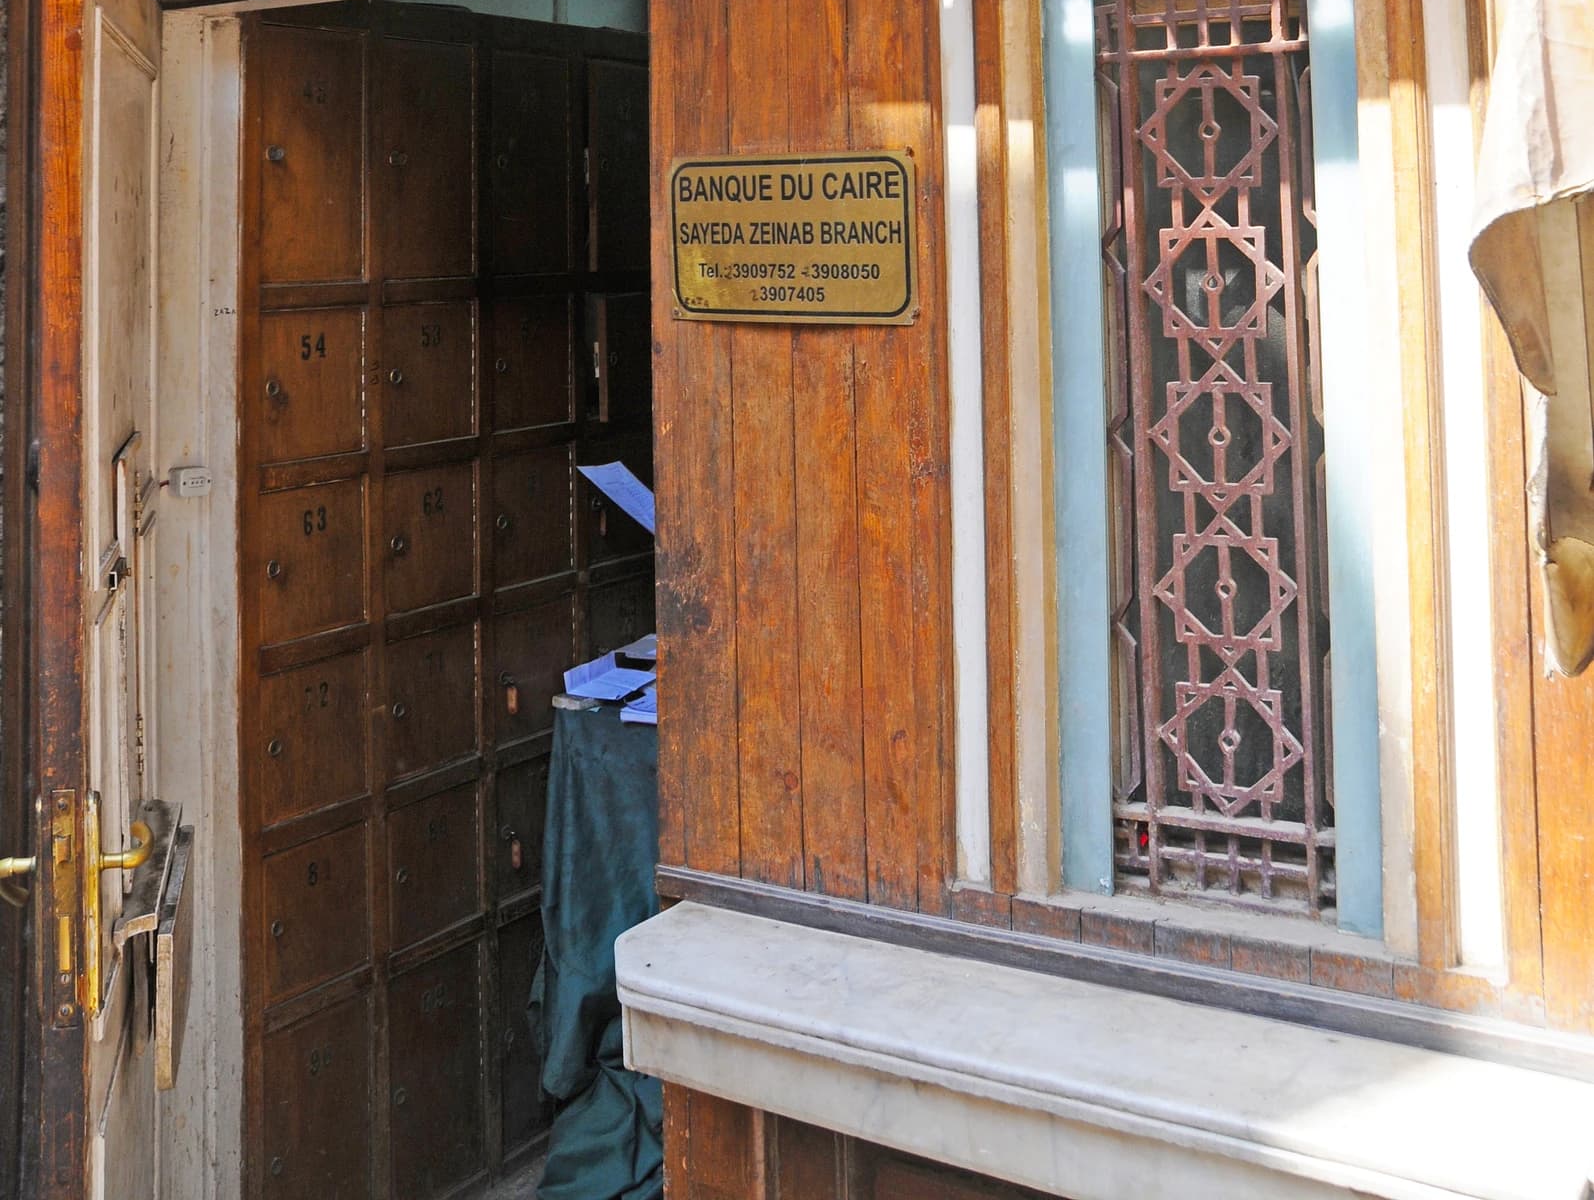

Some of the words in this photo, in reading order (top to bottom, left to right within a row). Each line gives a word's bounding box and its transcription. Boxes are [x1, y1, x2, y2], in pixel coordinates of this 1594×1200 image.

[679, 174, 773, 203] BANQUE
[780, 173, 814, 201] DU
[822, 171, 900, 200] CAIRE
[679, 222, 745, 245] SAYEDA
[750, 221, 814, 245] ZEINAB
[820, 220, 902, 245] BRANCH
[302, 332, 326, 360] 54
[423, 487, 444, 516] 62
[303, 506, 326, 535] 63
